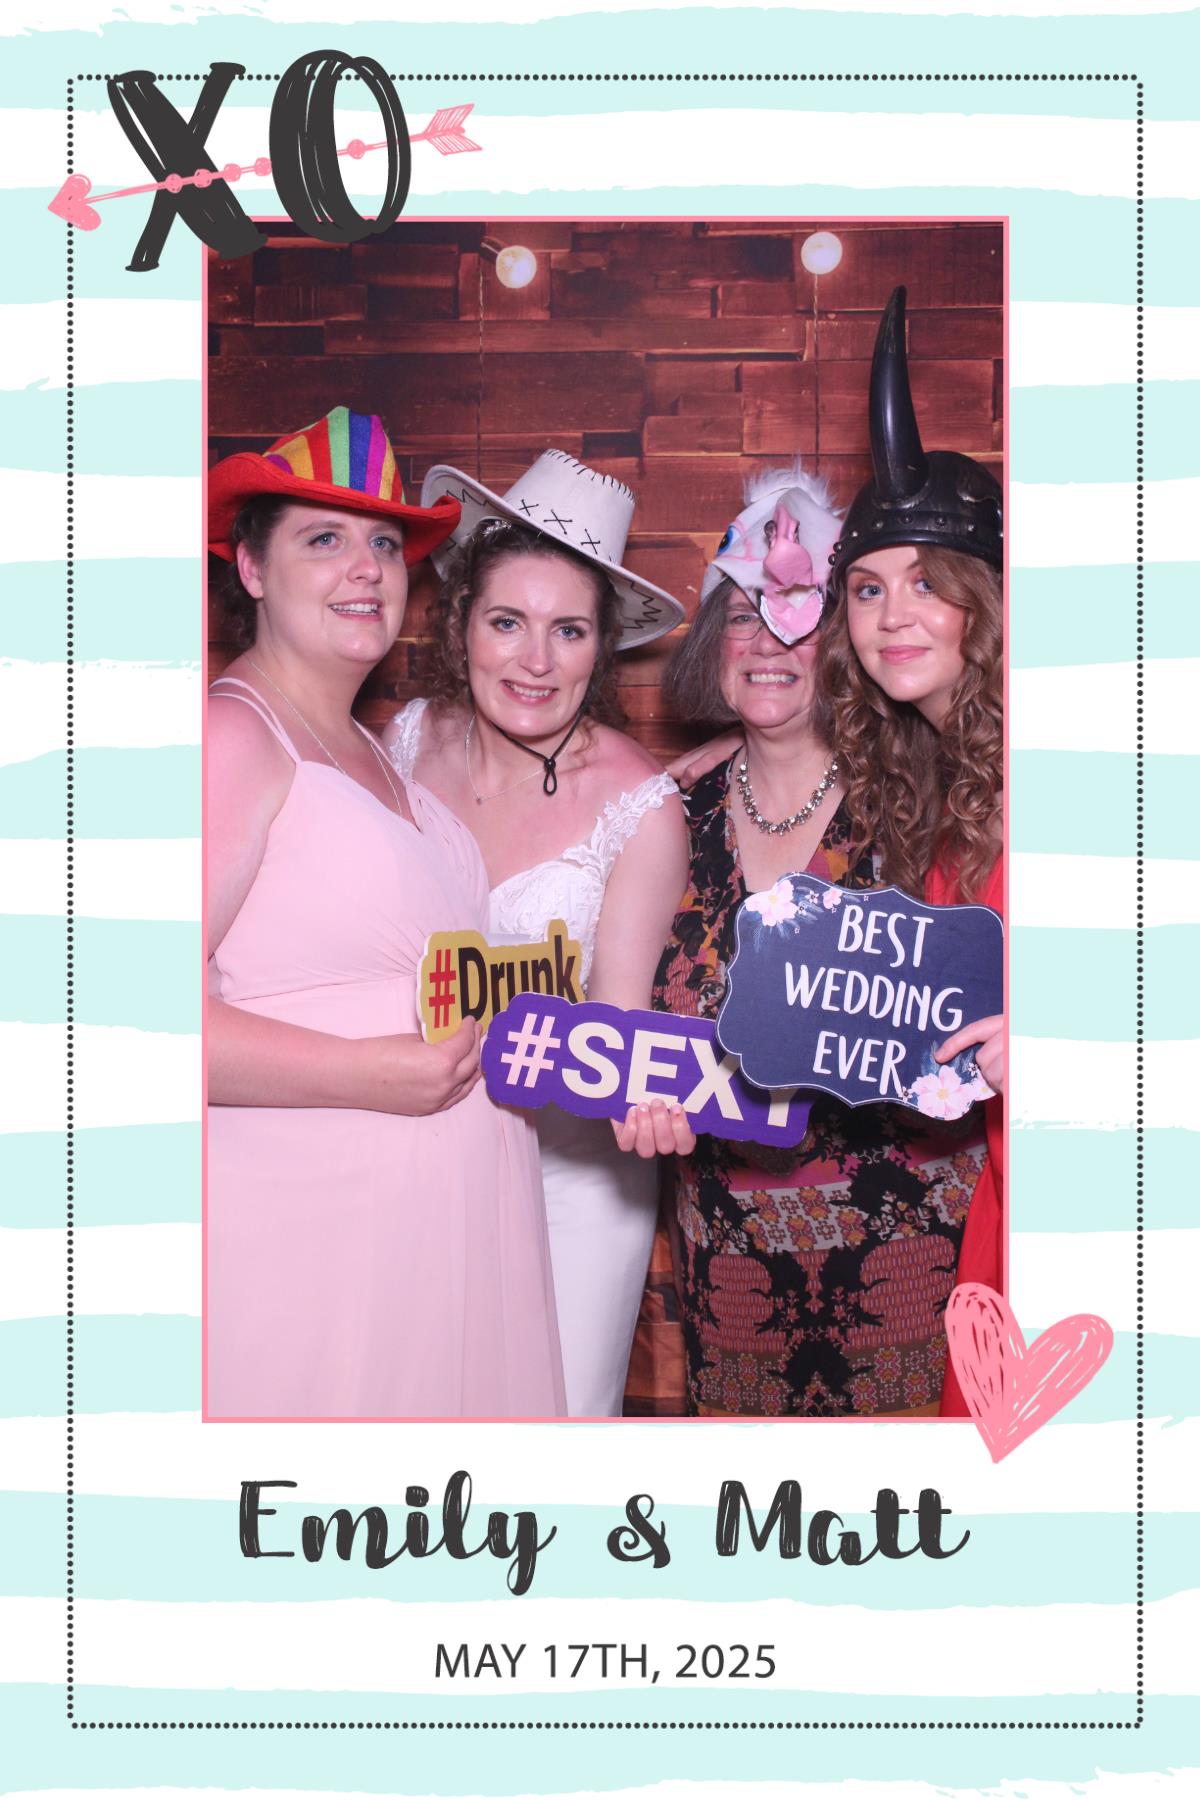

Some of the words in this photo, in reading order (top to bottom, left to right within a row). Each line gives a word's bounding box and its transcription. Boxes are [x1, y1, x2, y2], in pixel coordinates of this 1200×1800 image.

[837, 904, 935, 968] BEST
[429, 935, 578, 1029] #Drunk
[785, 962, 965, 1032] WEDDING
[813, 1031, 907, 1096] EVER
